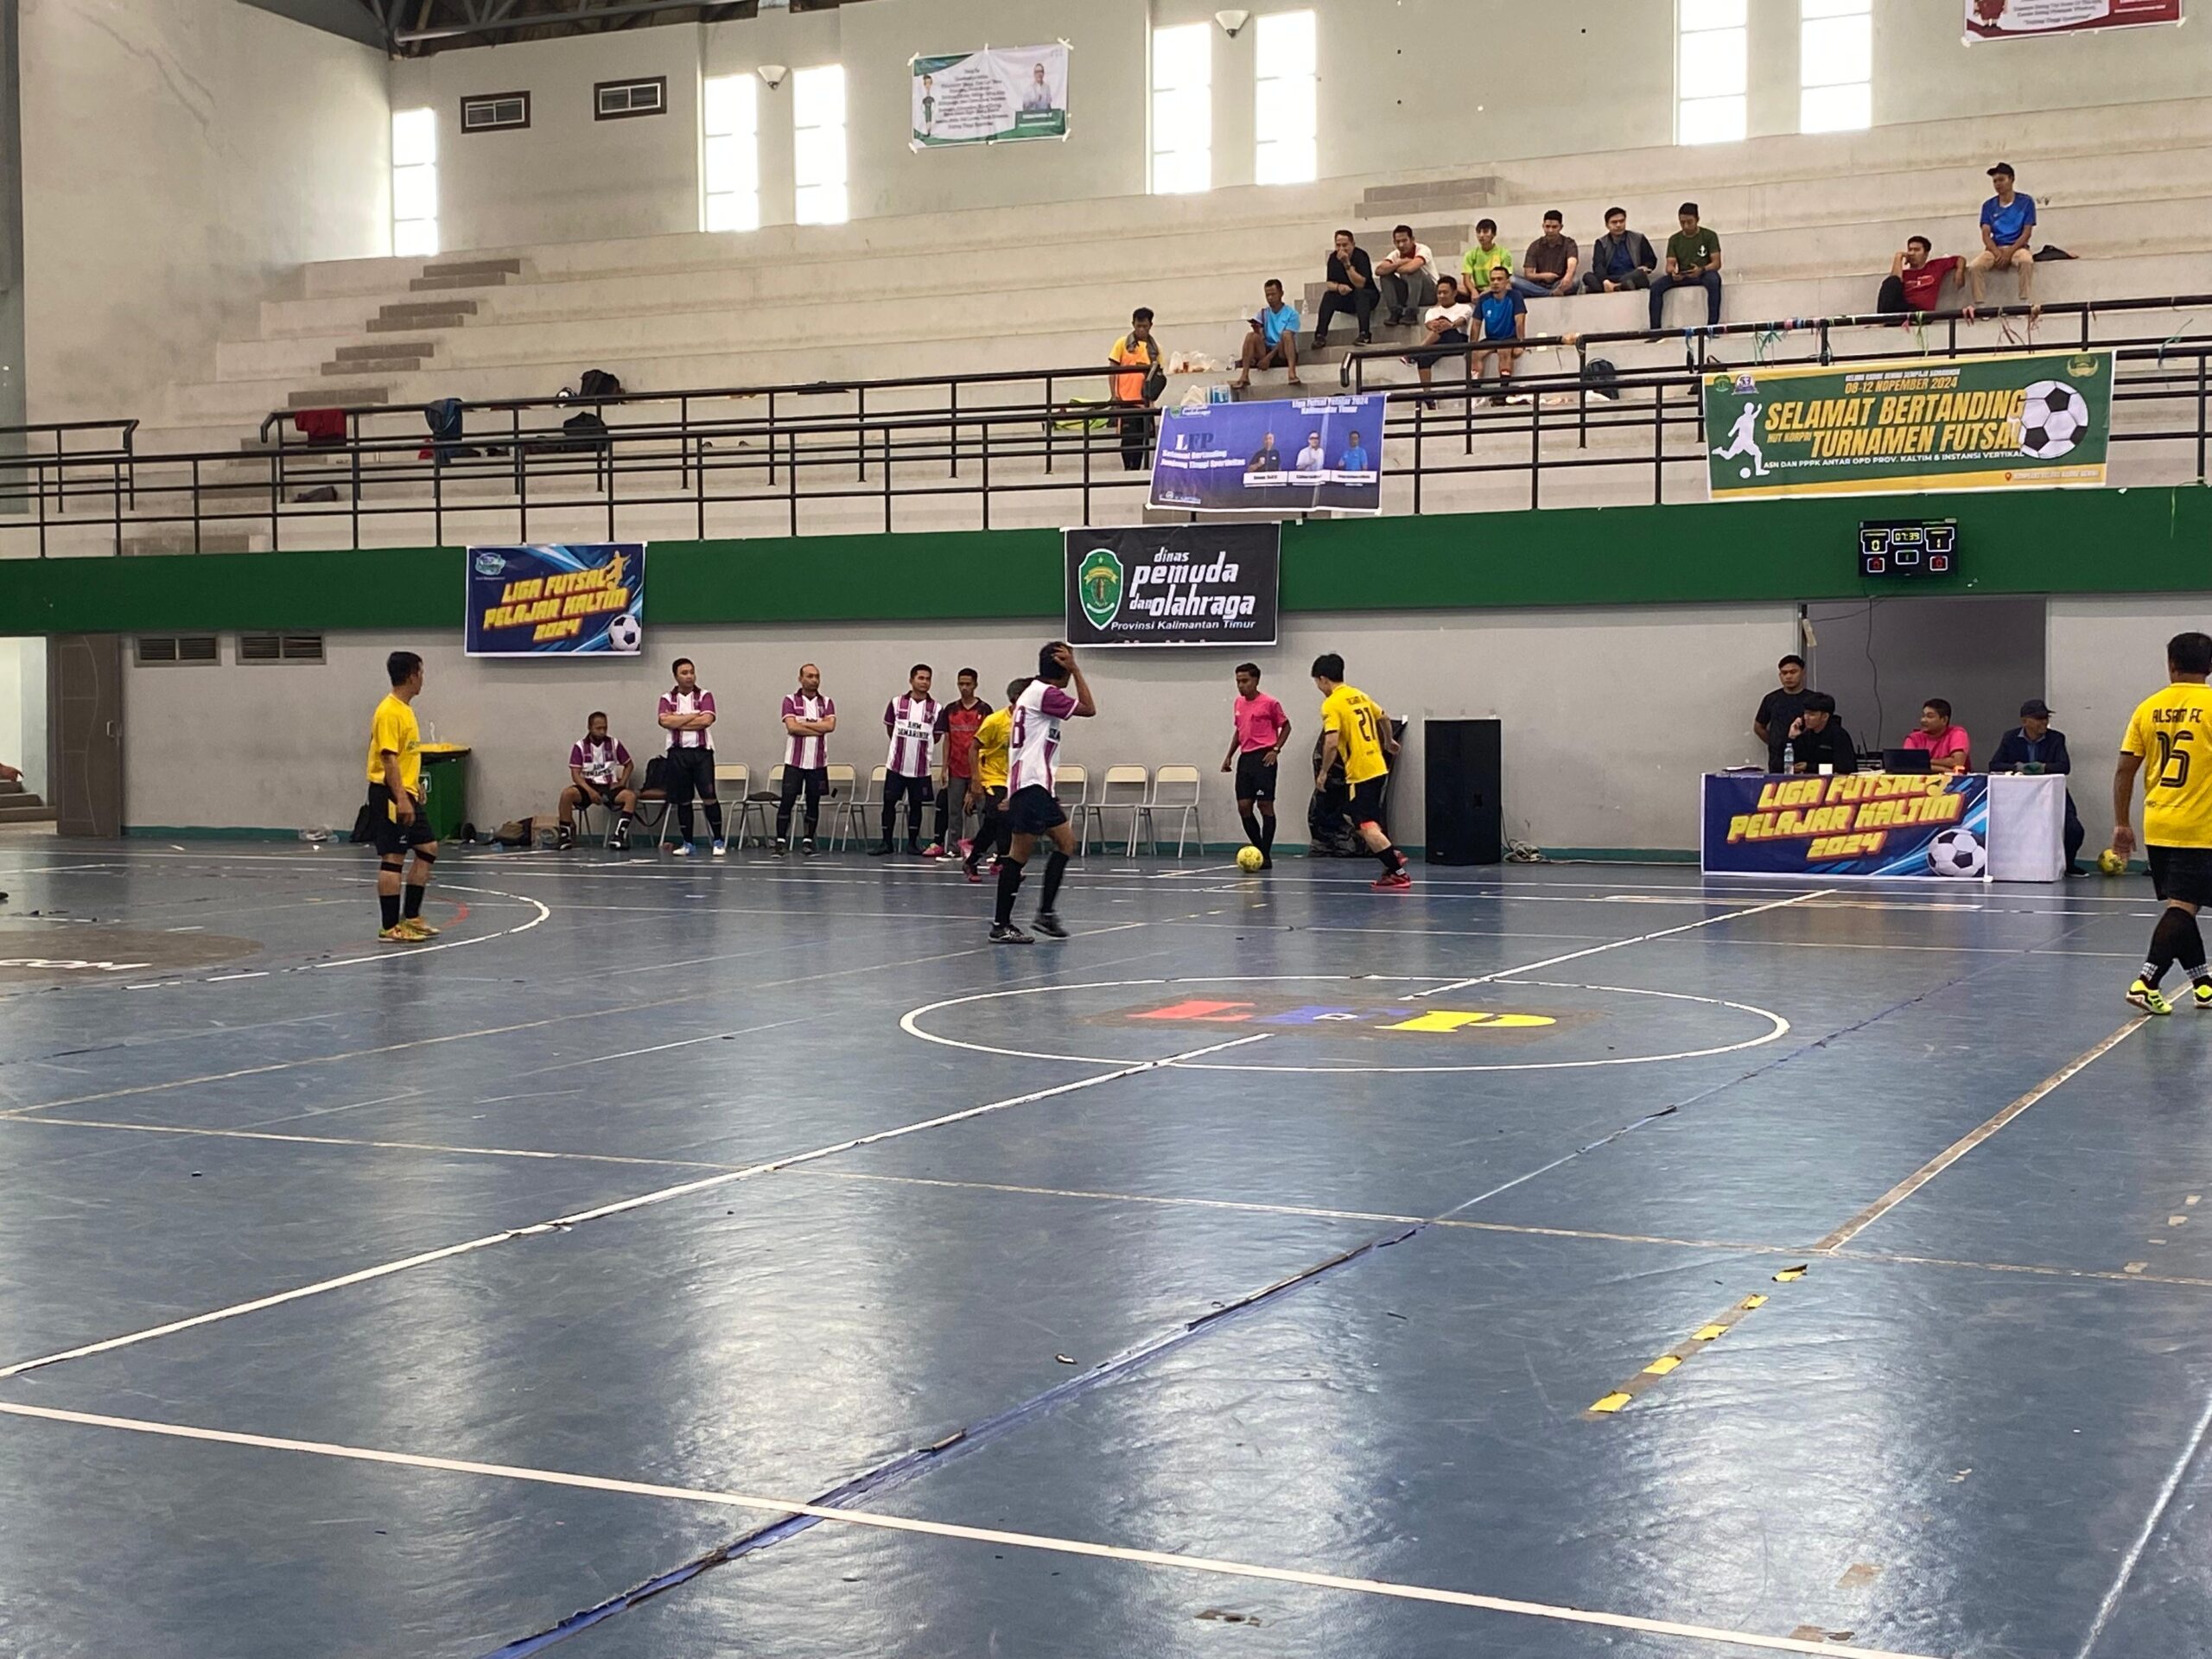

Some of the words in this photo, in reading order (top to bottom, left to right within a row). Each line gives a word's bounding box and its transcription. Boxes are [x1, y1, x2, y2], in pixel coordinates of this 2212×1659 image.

[1875, 378, 1929, 392] NOPEMBER
[1929, 376, 1959, 390] 2024
[1764, 397, 1877, 431] SELAMAT
[1878, 388, 2027, 425] BERTANDING
[1811, 425, 1936, 458] TURNAMEN
[1939, 420, 2020, 452] FUTSAL
[1942, 452, 1981, 461] INSTANSI
[1982, 450, 2024, 459] VERTIKAL
[1154, 546, 1190, 563] dinas
[501, 578, 544, 604] LIGA
[543, 568, 608, 597] FUTSAL
[1128, 550, 1239, 598] pemuda
[483, 598, 562, 631] PELAJAR
[562, 587, 629, 619] KALTIM
[1128, 593, 1153, 610] dan
[1148, 583, 1255, 620] olahraga
[532, 617, 583, 642] 2024
[1110, 621, 1154, 630] Provinsi
[1157, 620, 1219, 630] Kalimantan
[1223, 620, 1255, 629] Timur
[1757, 779, 1827, 811] LIGA
[1825, 775, 1929, 804] FUTSAL
[1727, 804, 1856, 843] PELAJAR
[1854, 793, 1965, 830] KALTIM
[1807, 830, 1889, 861] 2024
